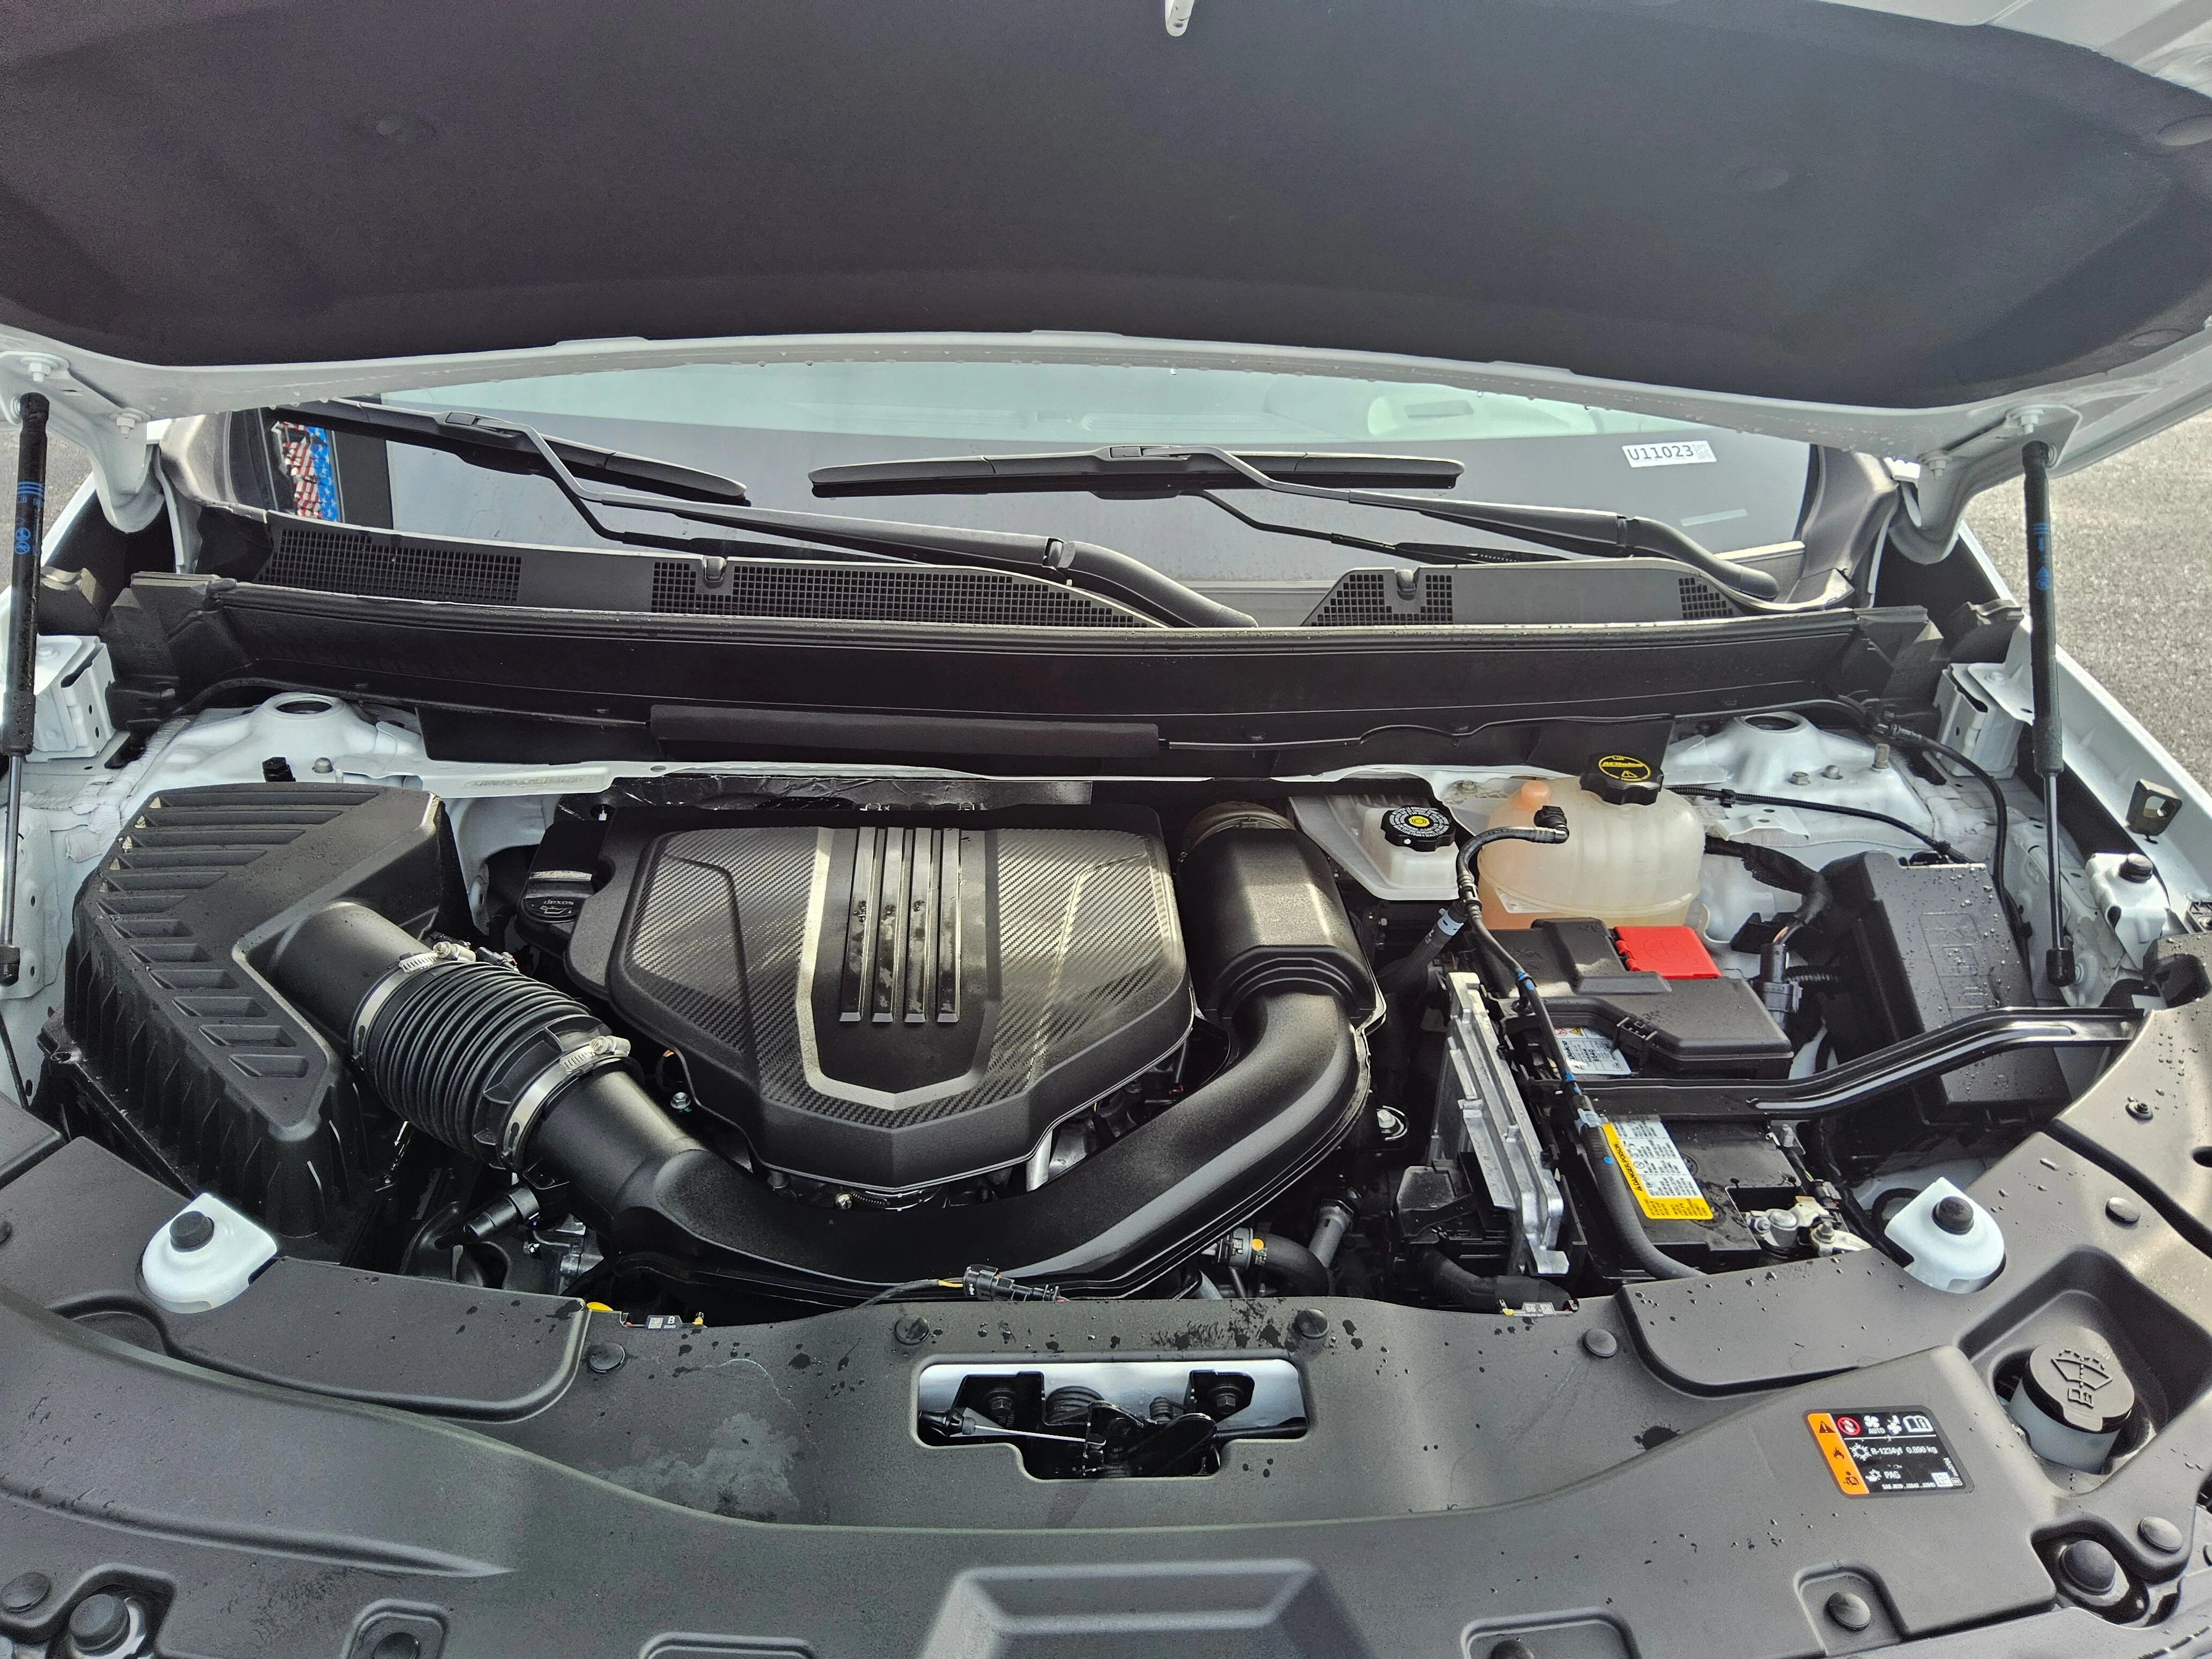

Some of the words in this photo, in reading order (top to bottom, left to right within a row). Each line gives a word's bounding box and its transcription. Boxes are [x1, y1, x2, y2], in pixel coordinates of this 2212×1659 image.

[1627, 445, 1694, 460] U11023
[1926, 1445, 1938, 1454] kg
[1883, 1470, 1902, 1479] PAG
